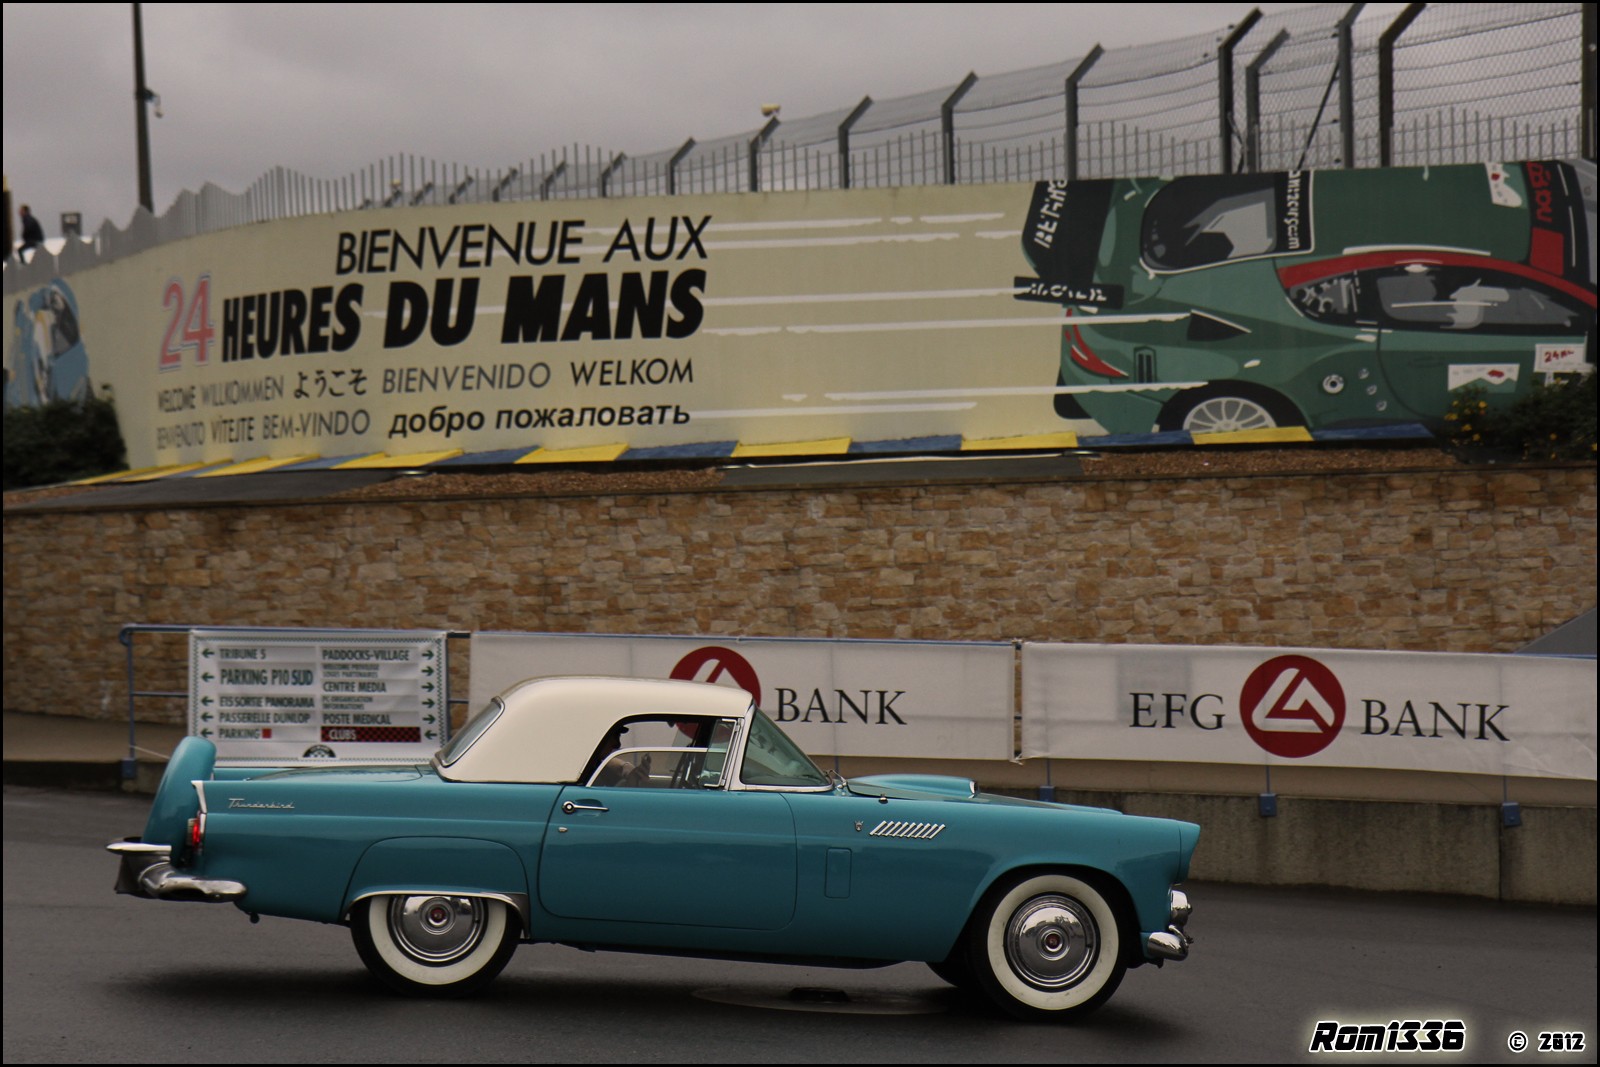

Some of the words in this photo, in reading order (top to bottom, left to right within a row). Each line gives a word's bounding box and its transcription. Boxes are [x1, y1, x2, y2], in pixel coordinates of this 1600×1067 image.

[336, 220, 585, 275] BIENVENUE
[602, 215, 712, 262] AUX
[158, 273, 215, 374] 24
[222, 282, 364, 362] HEURES
[383, 277, 480, 348] DU
[501, 268, 707, 344] MANS
[293, 368, 368, 398] ようこそ
[382, 362, 551, 394] BIENVENIDO
[570, 358, 693, 387] WELKOM
[202, 375, 284, 407] WILLKOMMEN
[262, 409, 370, 440] BEM-VINDO
[388, 405, 485, 439] добро
[495, 405, 691, 430] пожаловать
[220, 649, 257, 659] TRIBUNE
[322, 649, 410, 661] PADDOCKS-VILLAGE
[220, 668, 268, 685] PARKING
[271, 669, 289, 685] P10
[291, 669, 314, 686] SUD
[322, 681, 355, 692] CENTRE
[358, 682, 387, 692] MEDIA
[265, 697, 315, 708] PANORAMA
[774, 687, 908, 725] BANK
[219, 712, 271, 723] PASSERELLE
[273, 713, 311, 724] DUNLOP
[322, 713, 350, 724] POSTE
[352, 714, 392, 725] MEDICAL
[1128, 692, 1226, 730] EFG
[1361, 699, 1511, 741] BANK
[219, 728, 261, 739] PARKING
[328, 729, 357, 740] CLUBS
[228, 798, 296, 809] Thunderbird
